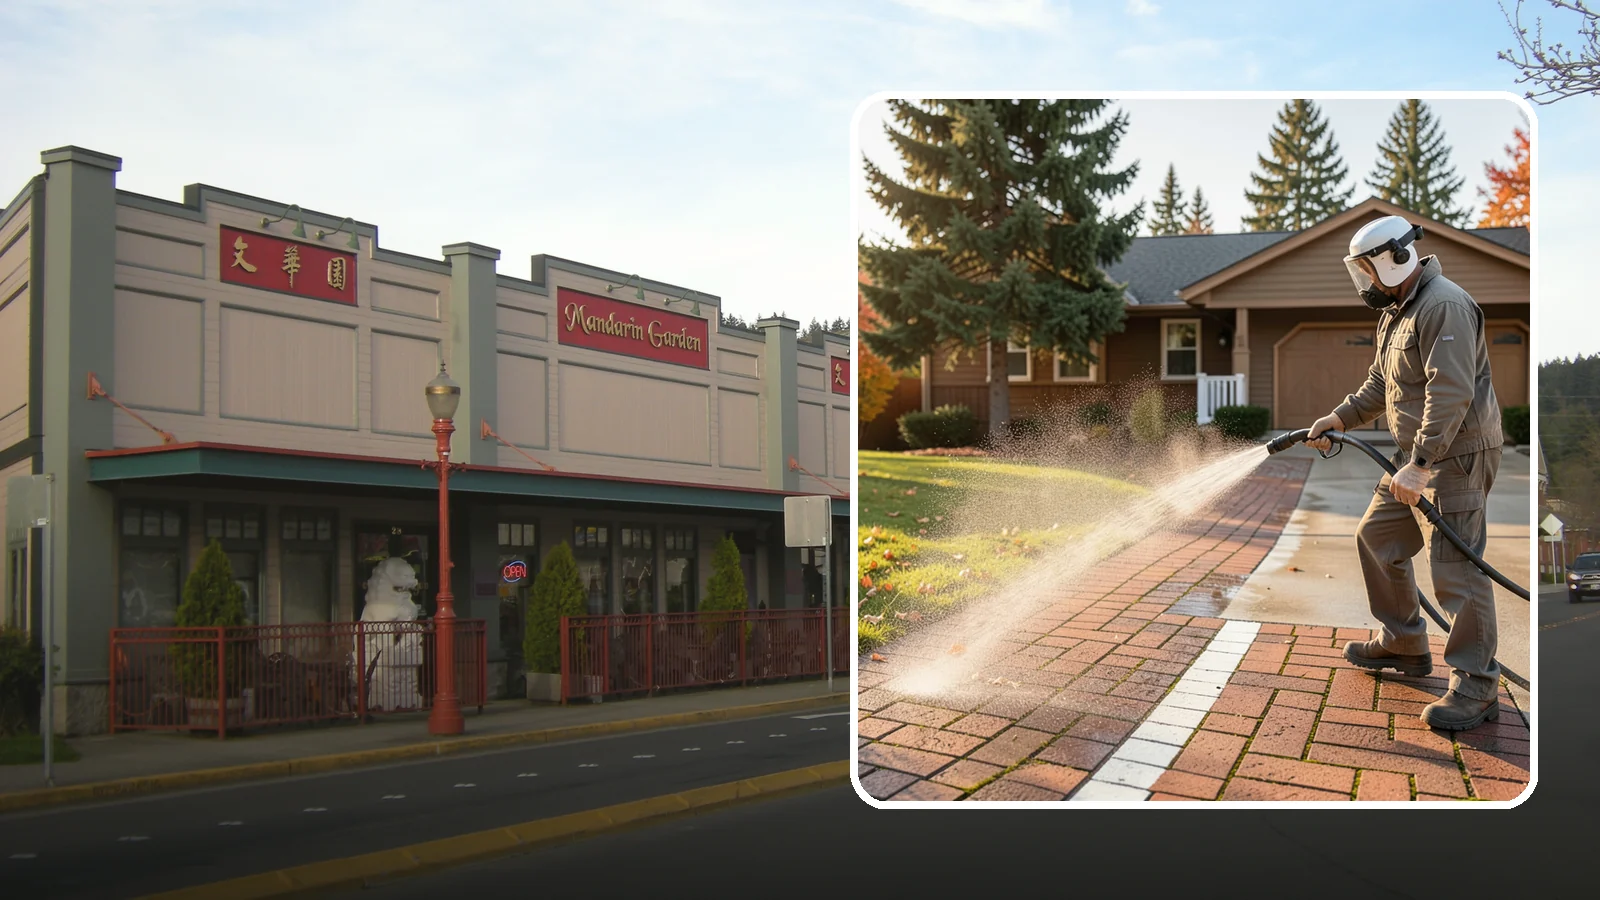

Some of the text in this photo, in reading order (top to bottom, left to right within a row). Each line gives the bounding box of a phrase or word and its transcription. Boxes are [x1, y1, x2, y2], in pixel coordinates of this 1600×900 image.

[231, 235, 346, 290] 文華園
[564, 302, 701, 352] Mandarin Garden
[503, 565, 527, 578] OPEN
